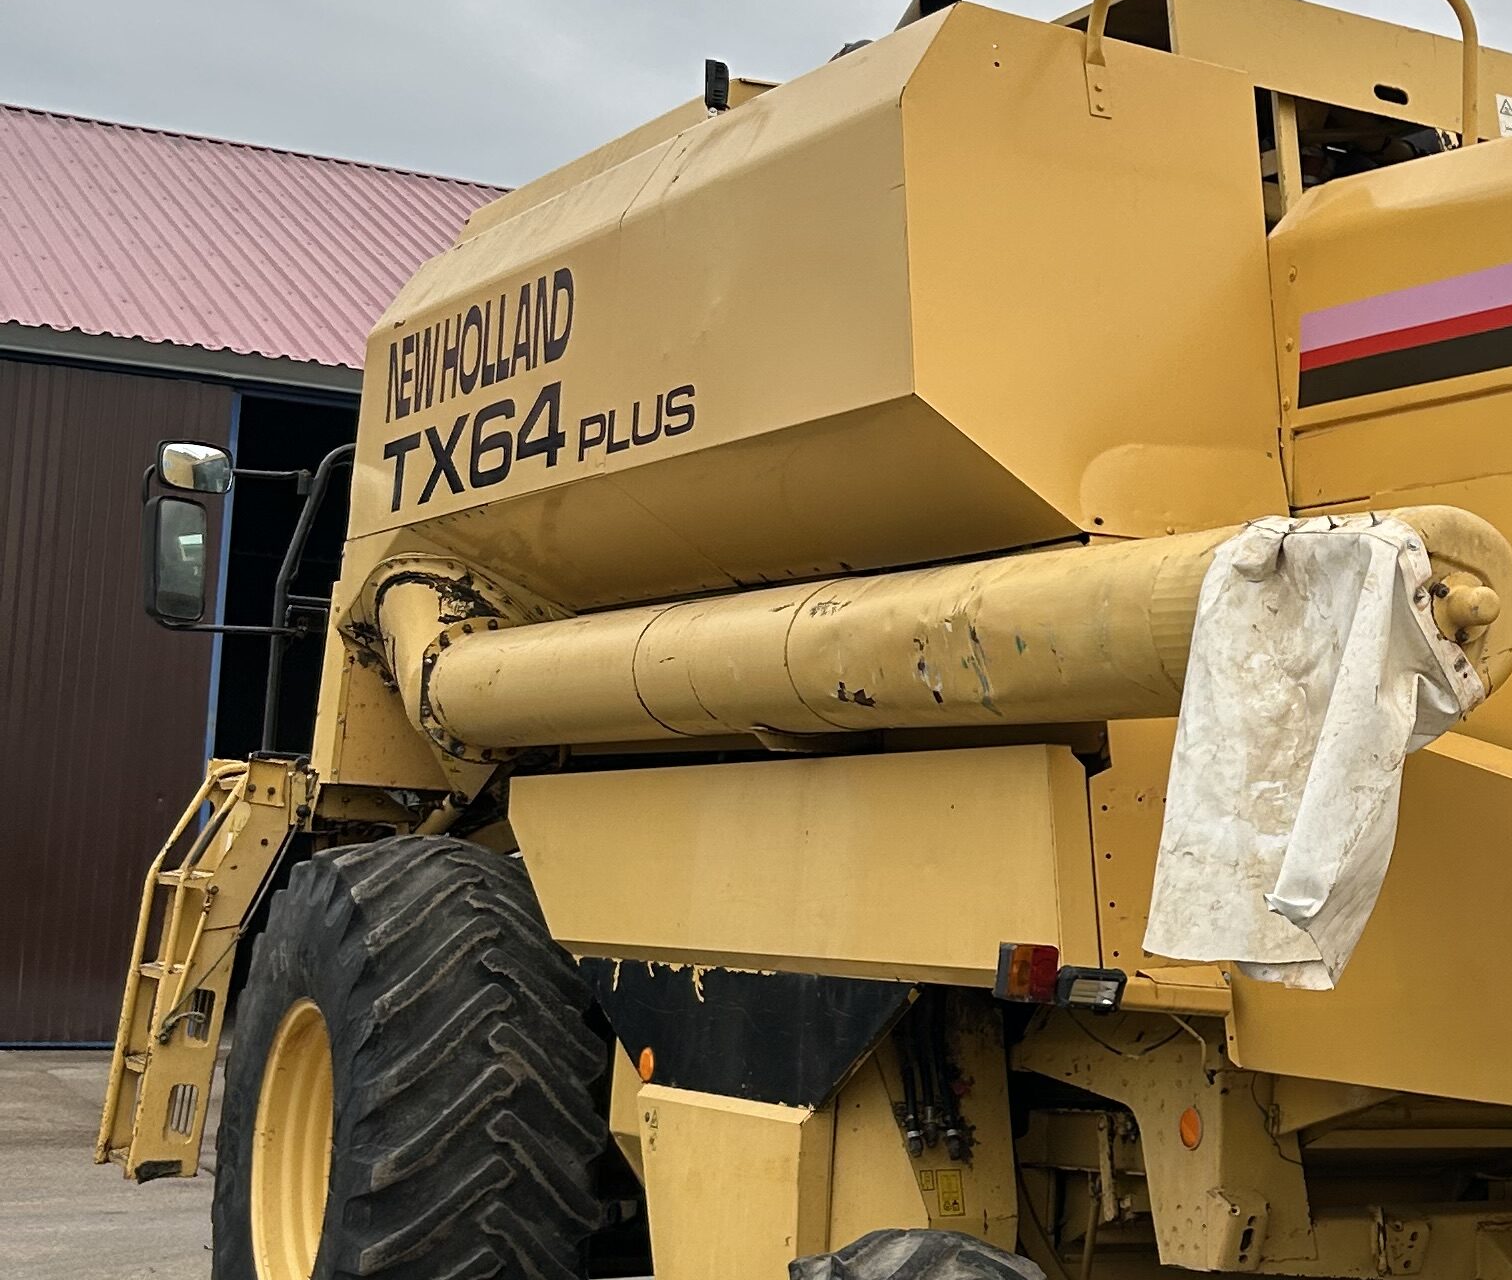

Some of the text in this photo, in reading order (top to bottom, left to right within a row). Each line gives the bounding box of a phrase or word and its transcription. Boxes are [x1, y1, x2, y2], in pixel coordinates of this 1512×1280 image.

[385, 267, 574, 423] NEW HOLLAND
[383, 381, 696, 513] TX64 PLUS
